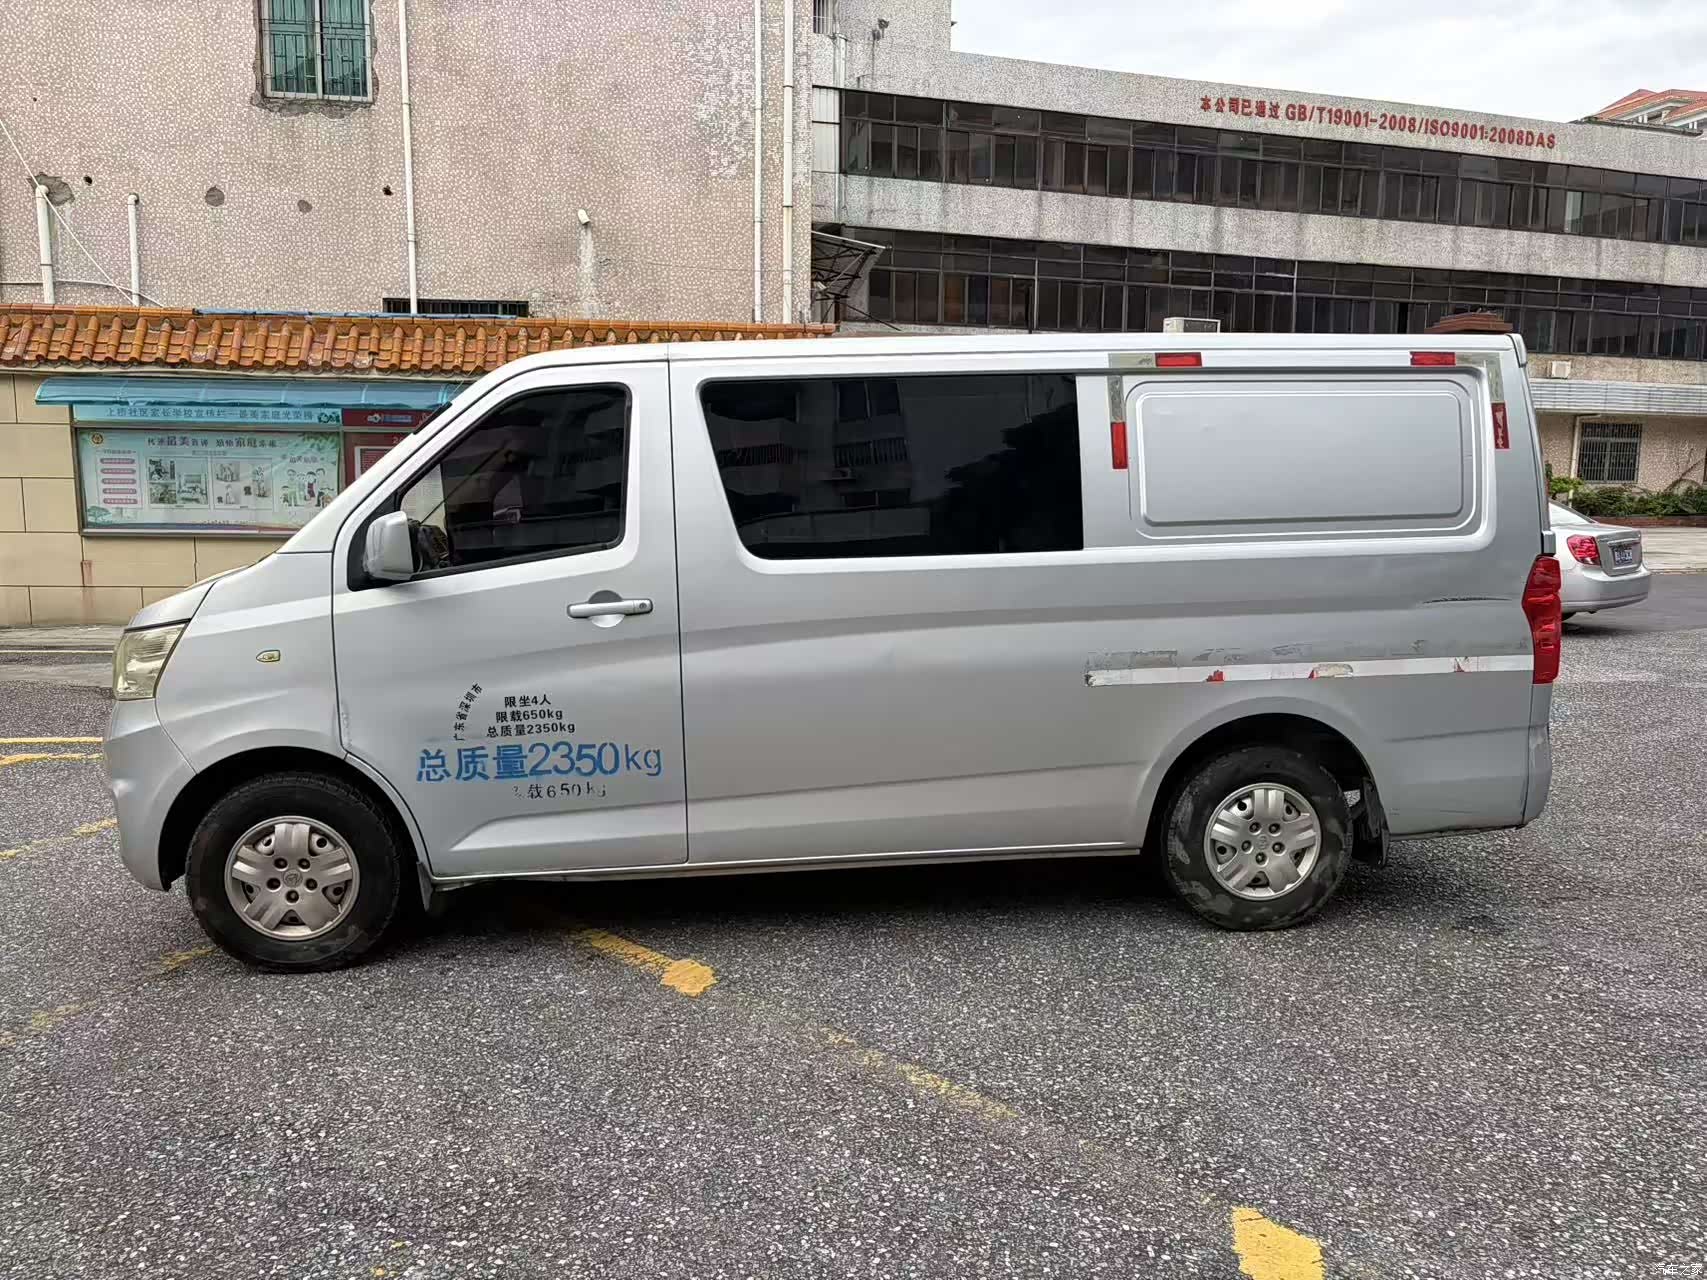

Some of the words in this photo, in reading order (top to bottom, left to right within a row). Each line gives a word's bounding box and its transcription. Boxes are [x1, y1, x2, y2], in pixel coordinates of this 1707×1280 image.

[1200, 95, 1280, 119] 本公司已通过
[504, 694, 551, 708] 限坐4人
[453, 683, 483, 741] 广东省深圳市
[496, 709, 563, 723] 限载650kg
[487, 723, 575, 738] 总质量2350kg
[416, 741, 663, 782] 总质量2350kg
